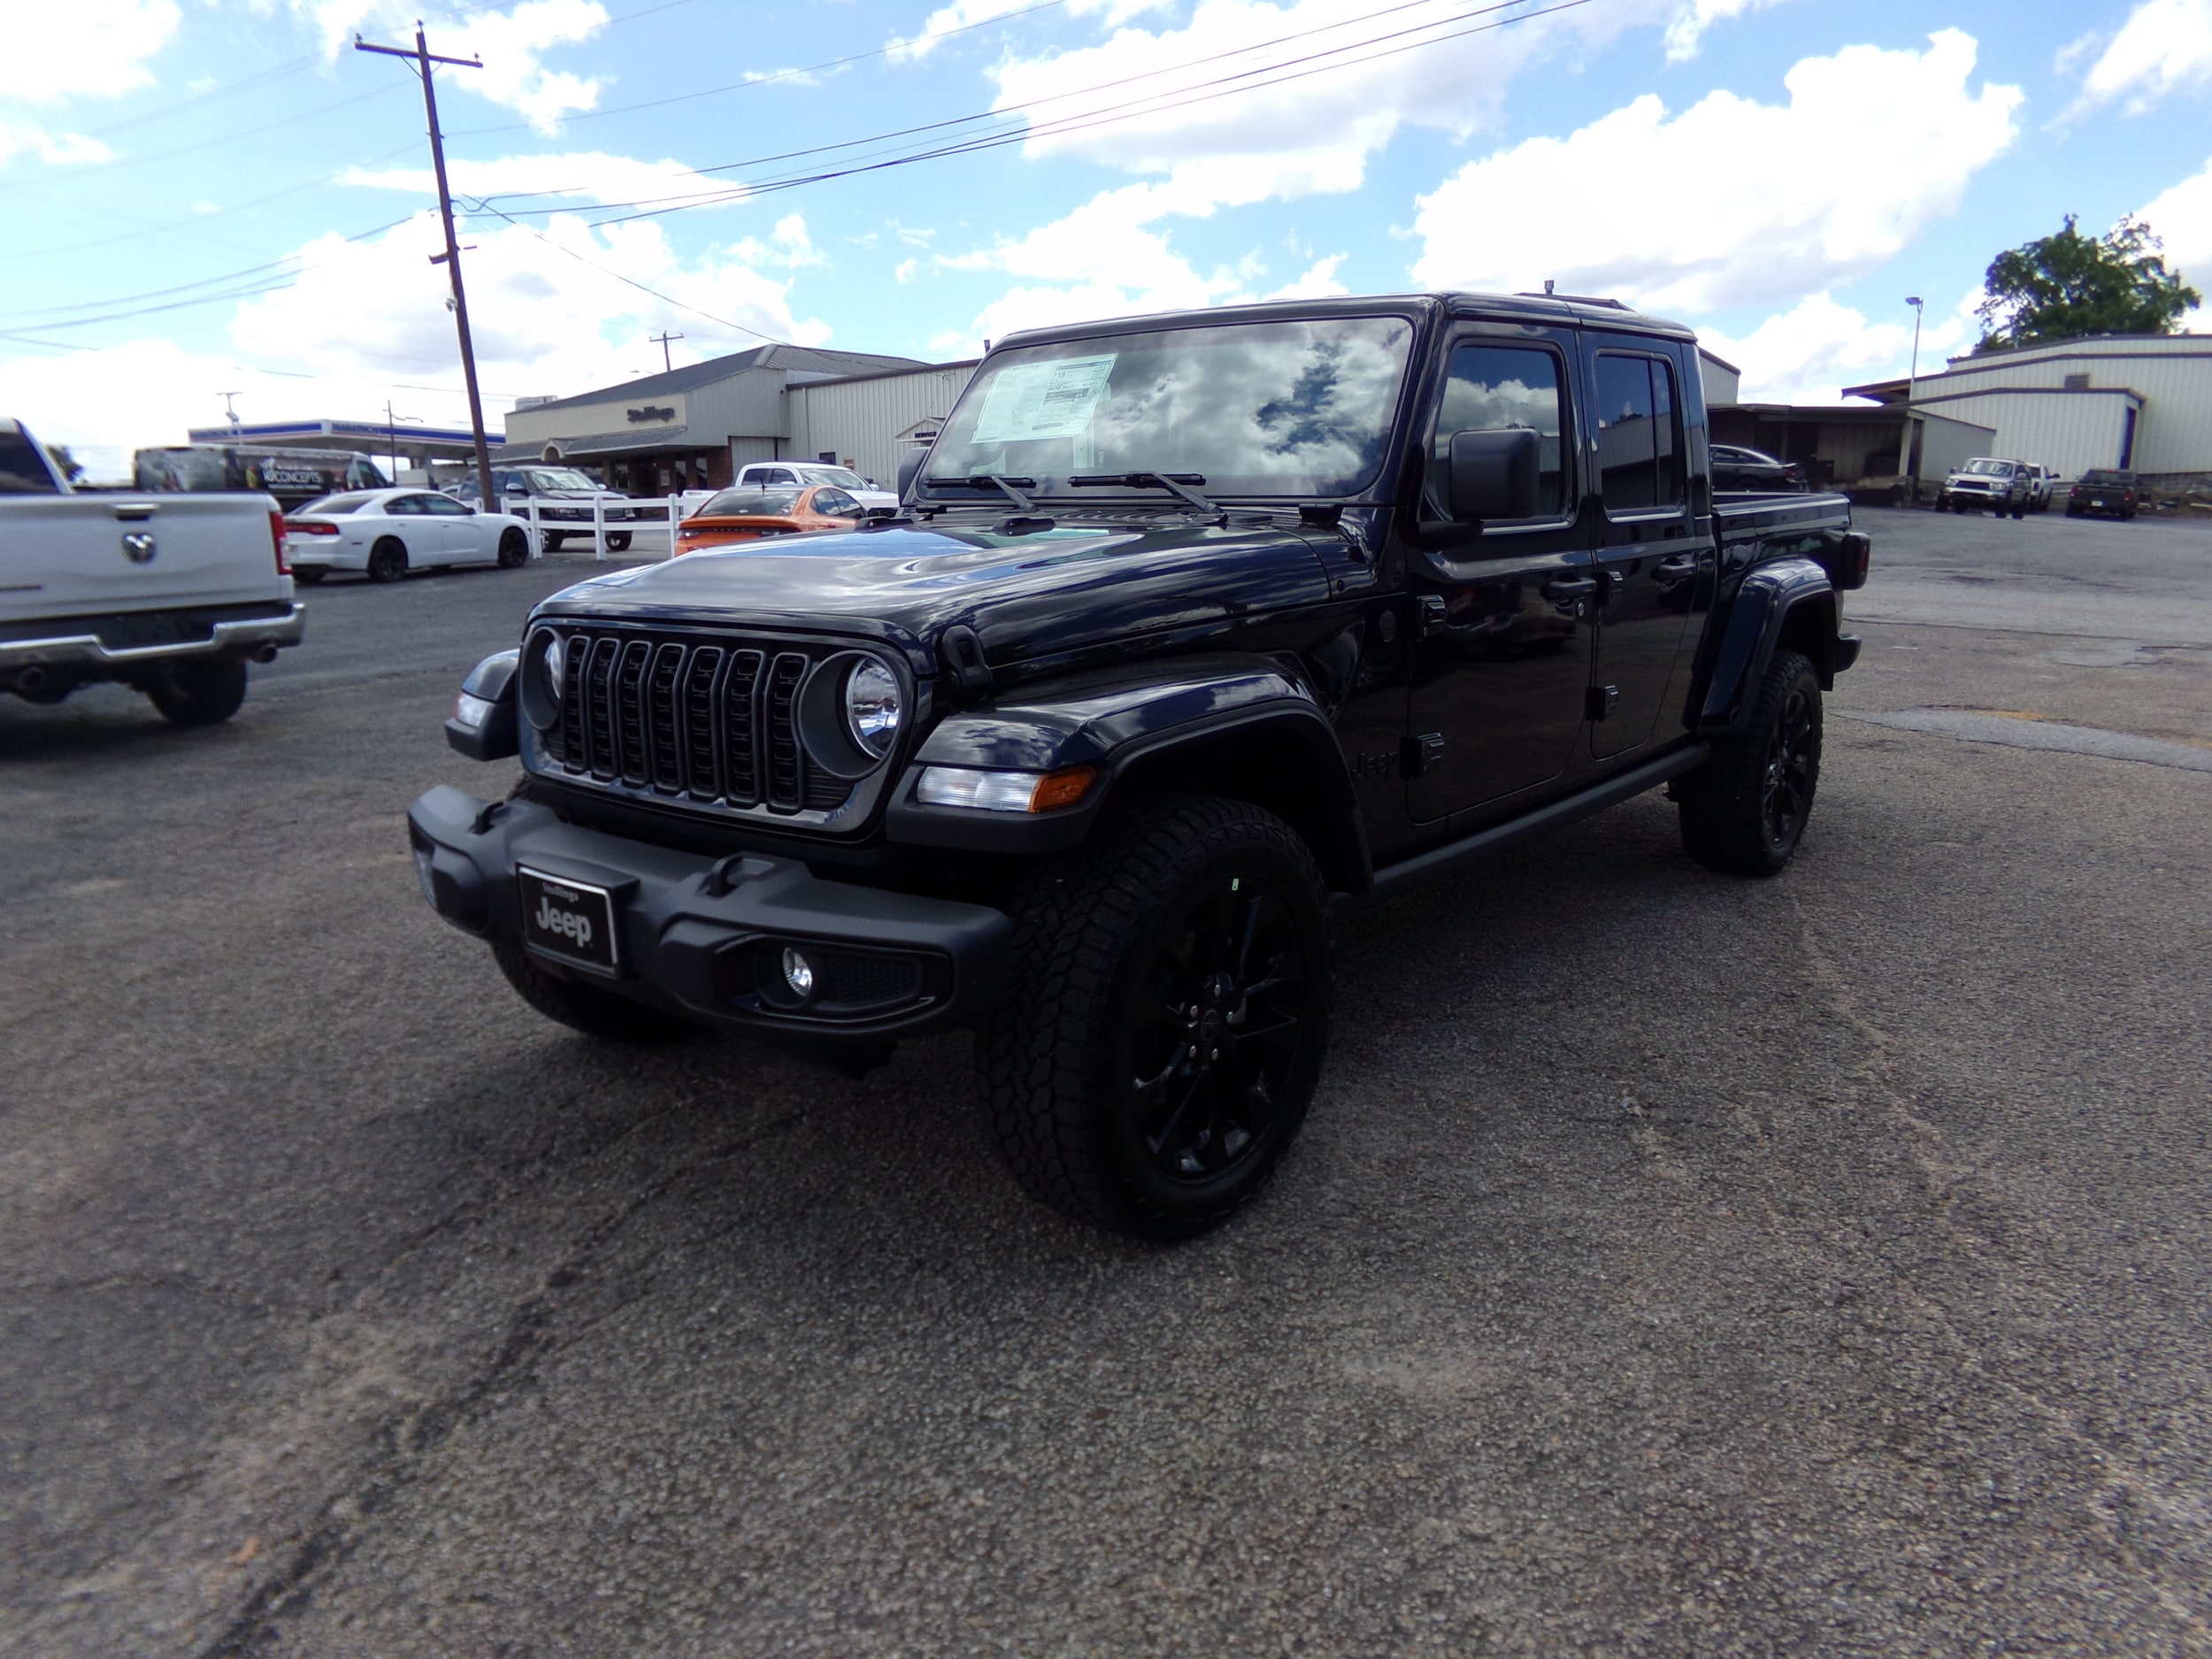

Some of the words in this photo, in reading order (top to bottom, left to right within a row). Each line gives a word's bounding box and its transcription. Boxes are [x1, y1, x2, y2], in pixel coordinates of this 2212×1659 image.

[1351, 751, 1397, 781] Jeep
[541, 882, 580, 903] Stallings
[535, 896, 592, 948] Jeep
